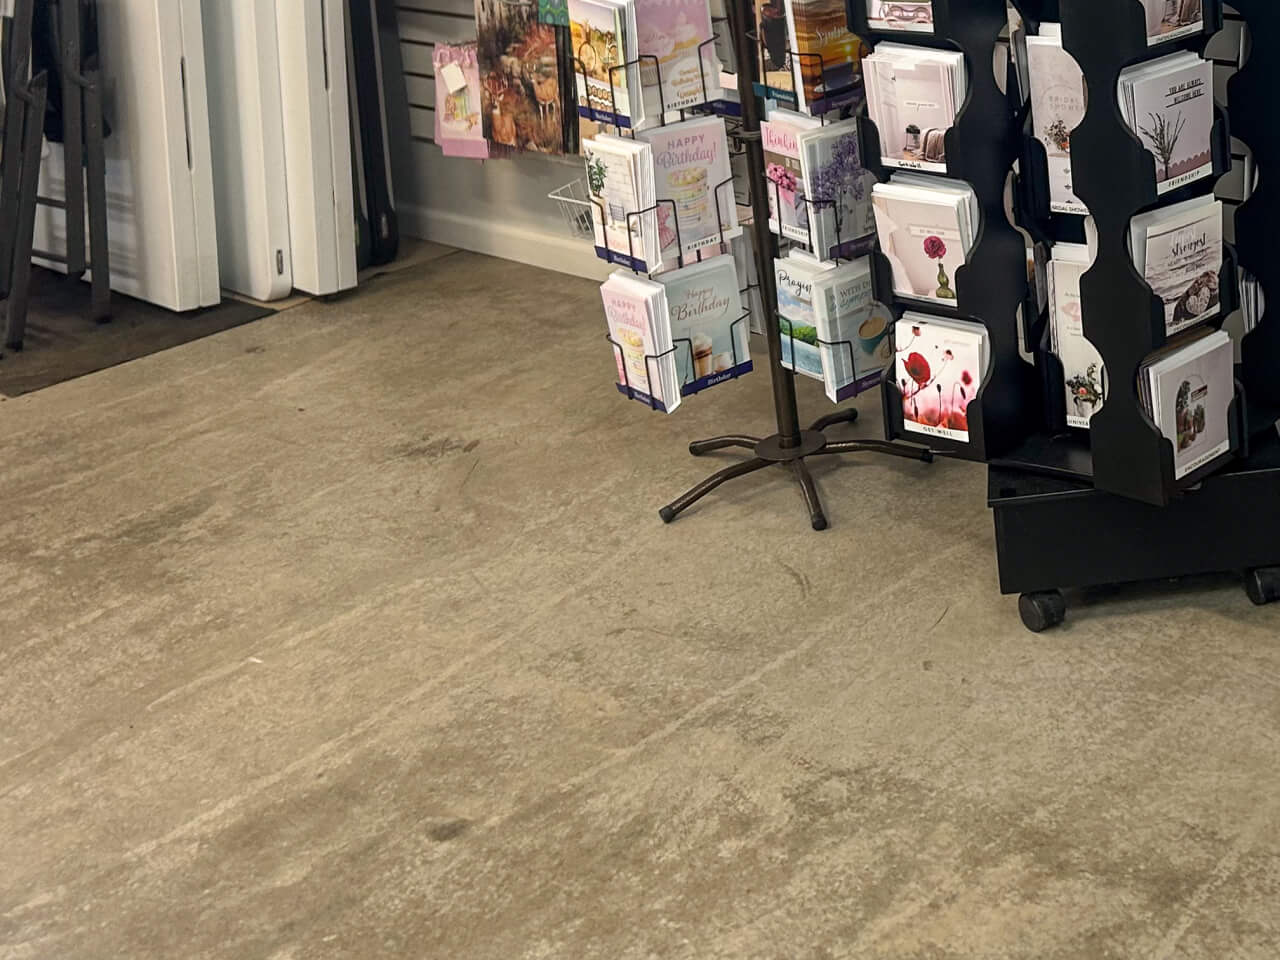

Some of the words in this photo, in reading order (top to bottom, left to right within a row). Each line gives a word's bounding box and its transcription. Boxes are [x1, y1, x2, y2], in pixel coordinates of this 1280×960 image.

[666, 96, 699, 110] BIRTHDAY
[666, 133, 705, 150] HAPPY
[656, 142, 718, 169] Birthday!
[1168, 170, 1202, 189] FRIENDSHIP
[686, 235, 719, 252] BIRTHDAY
[671, 296, 732, 322] Birthday
[706, 372, 733, 384] Birthday
[922, 425, 937, 434] GET
[937, 428, 954, 438] WELL
